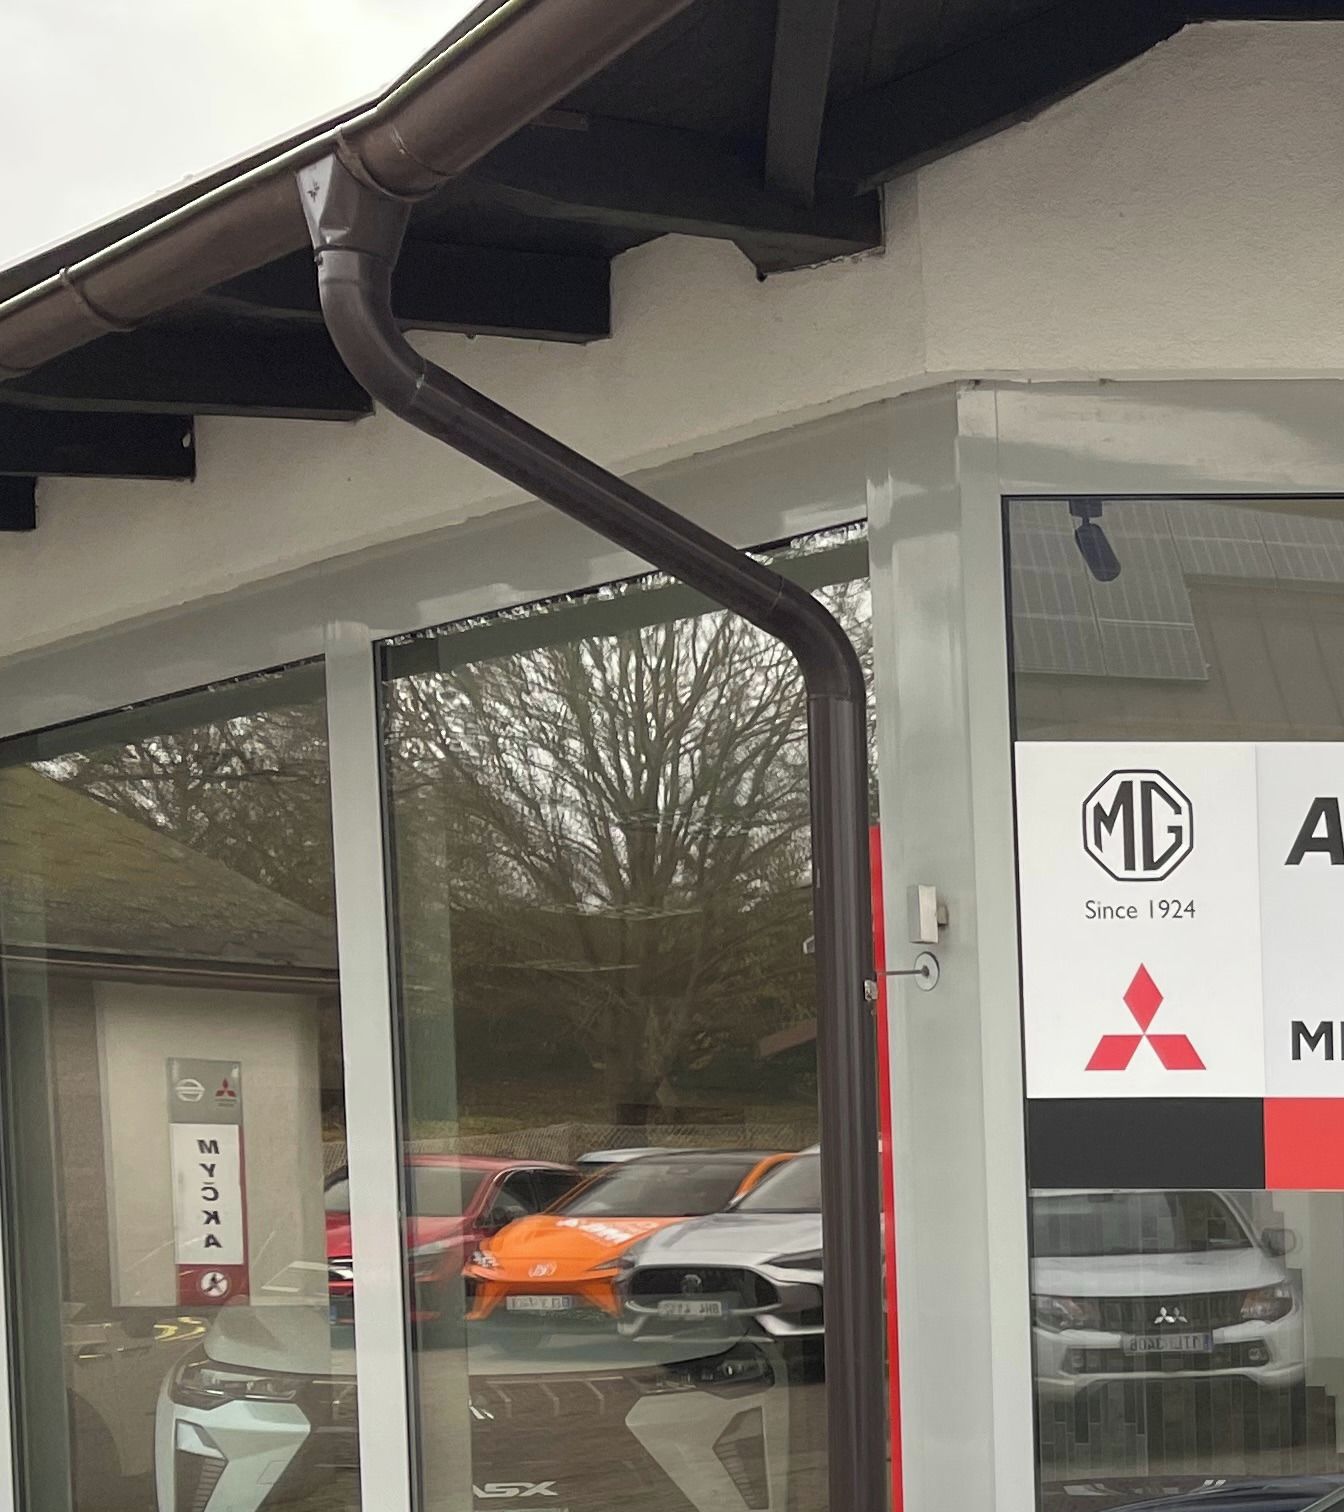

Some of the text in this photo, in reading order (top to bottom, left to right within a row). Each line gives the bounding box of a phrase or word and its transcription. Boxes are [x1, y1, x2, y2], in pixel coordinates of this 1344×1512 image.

[1088, 775, 1189, 876] MG
[1084, 899, 1196, 920] Since 1924
